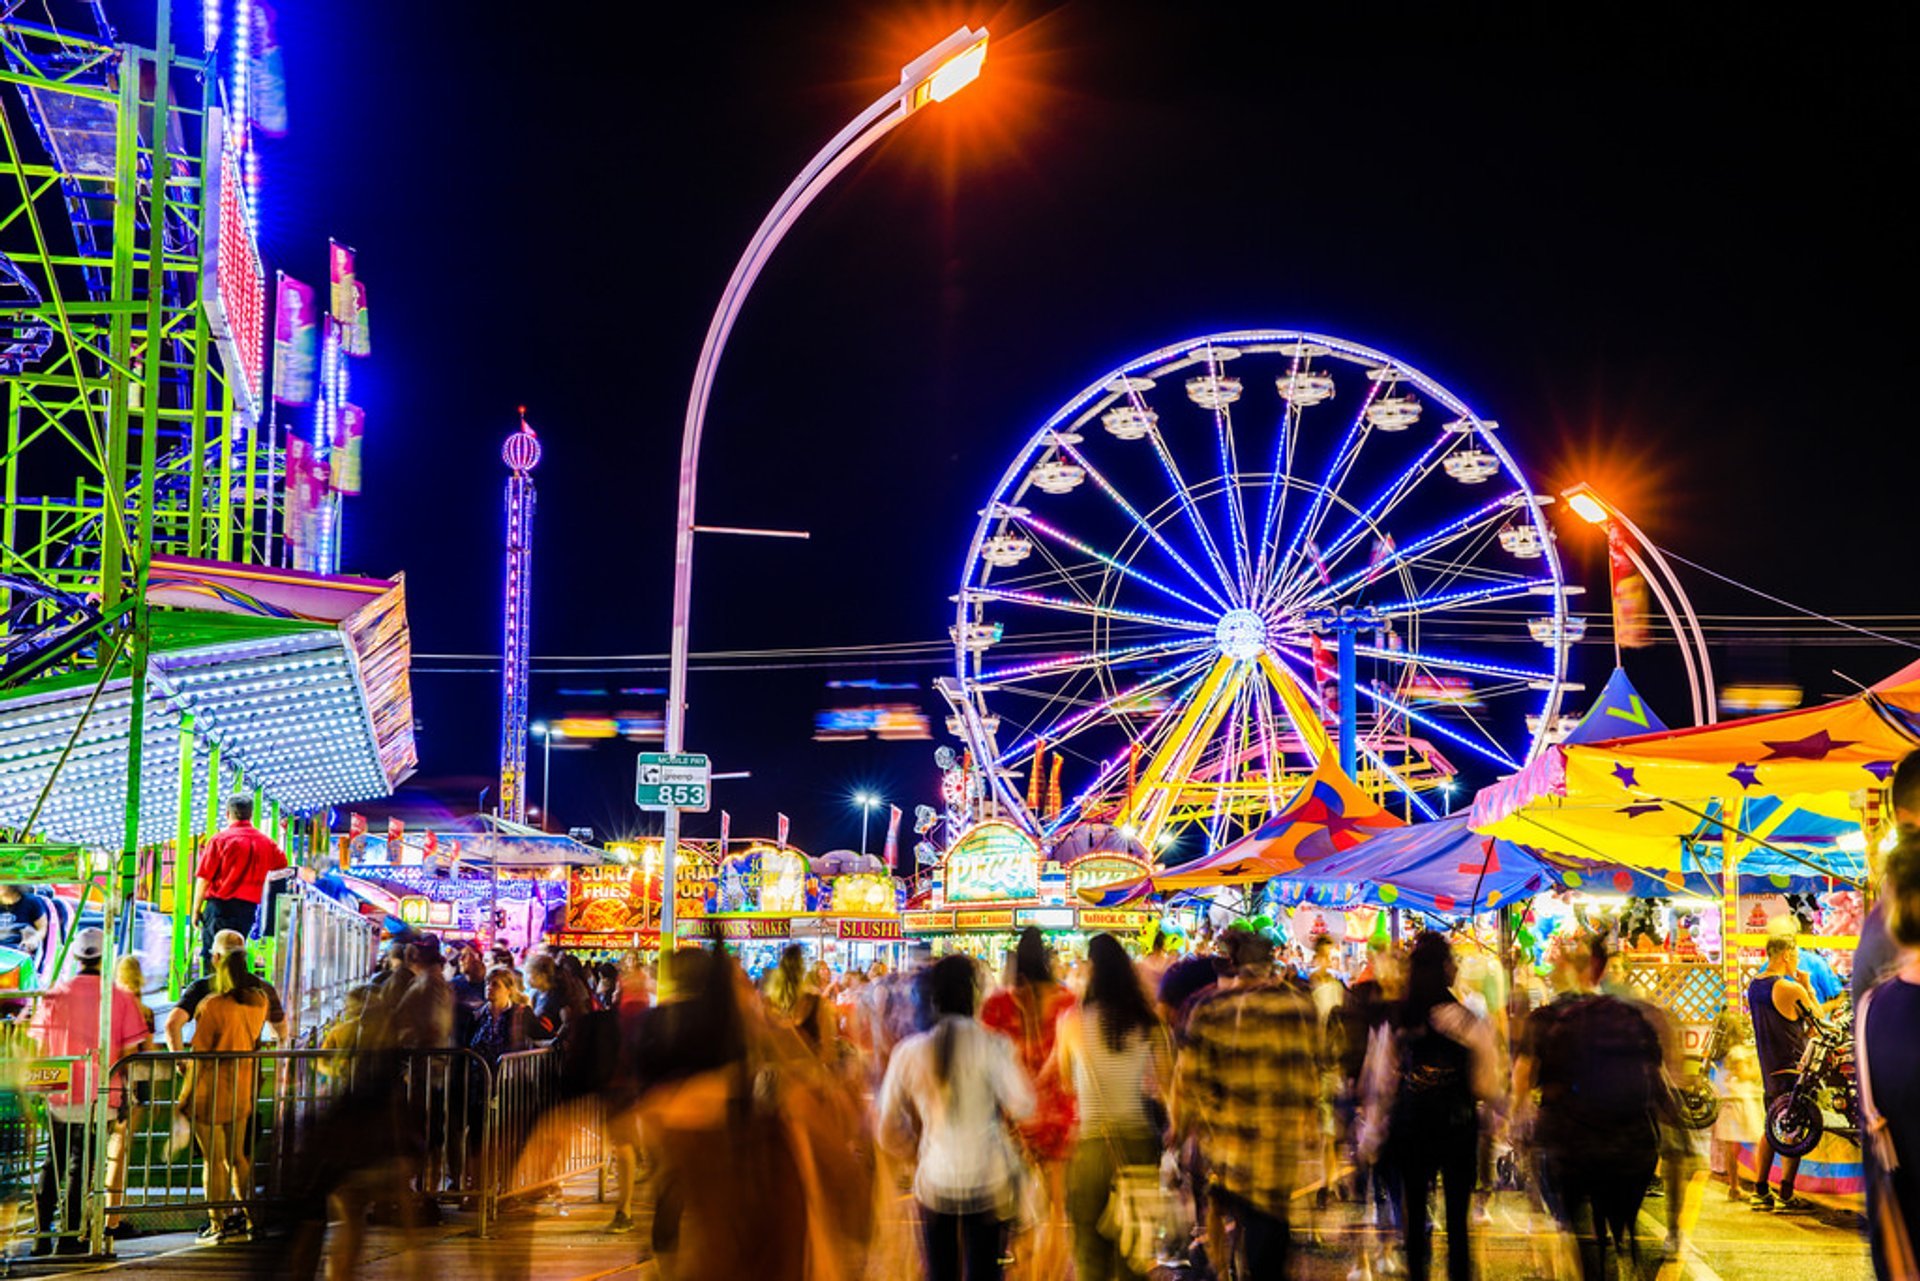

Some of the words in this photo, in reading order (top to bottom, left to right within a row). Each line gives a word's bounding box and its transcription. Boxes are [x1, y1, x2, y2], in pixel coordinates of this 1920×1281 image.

[658, 786, 703, 804] 853
[949, 854, 1035, 893] PIZZA
[583, 883, 631, 899] FRIES
[751, 920, 789, 936] SHAKES
